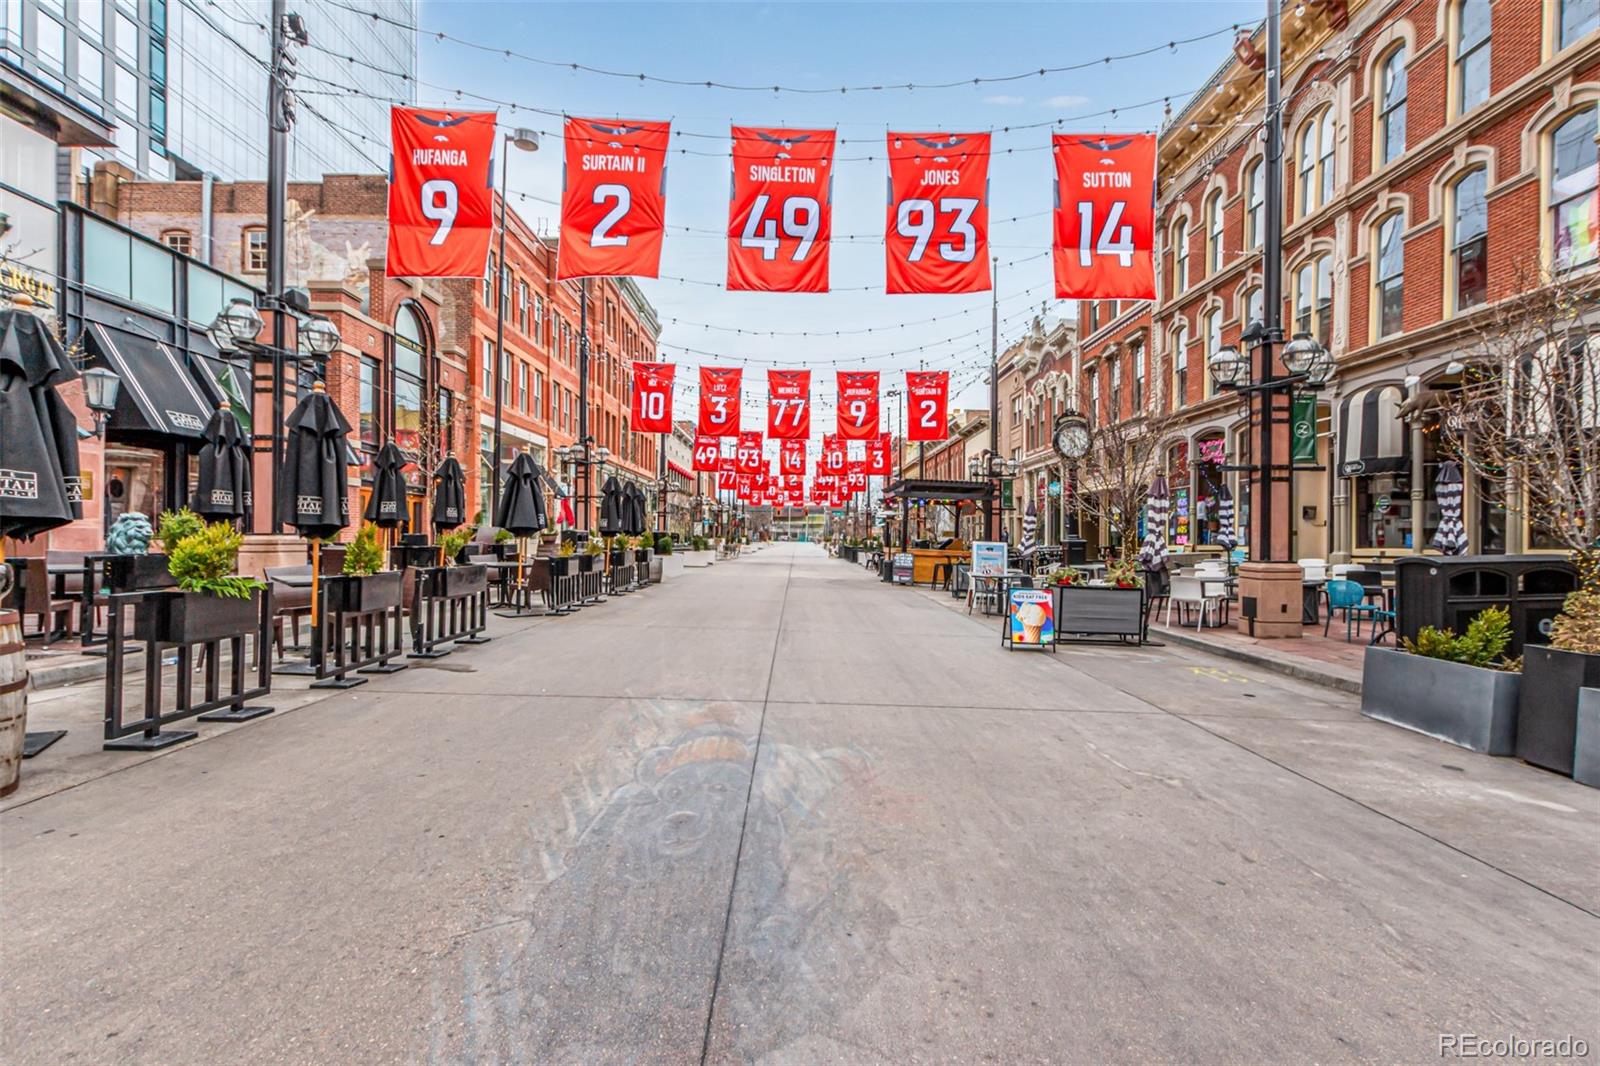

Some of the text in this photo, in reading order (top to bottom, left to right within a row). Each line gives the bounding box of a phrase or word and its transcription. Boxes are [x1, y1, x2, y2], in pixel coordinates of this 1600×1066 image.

[412, 147, 467, 167] HUFANGA
[582, 153, 646, 173] SURTAIN II
[749, 164, 816, 184] SINGLETON
[920, 169, 960, 186] JONES
[1082, 171, 1132, 189] SUTTON
[420, 178, 458, 245] 9
[590, 183, 631, 247] 2
[740, 194, 821, 261] 49
[896, 197, 979, 262] 93
[1077, 200, 1135, 267] 14
[640, 391, 664, 420] 10
[710, 396, 727, 424] 3
[771, 399, 805, 426] 77
[850, 400, 866, 427] 9
[920, 399, 937, 427] 2
[695, 446, 717, 464] 49
[738, 449, 759, 467] 93
[785, 450, 801, 469] 14
[827, 451, 843, 469] 10
[872, 450, 884, 468] 3
[720, 471, 735, 485] 77
[789, 475, 798, 486] 2
[848, 473, 864, 486] 93
